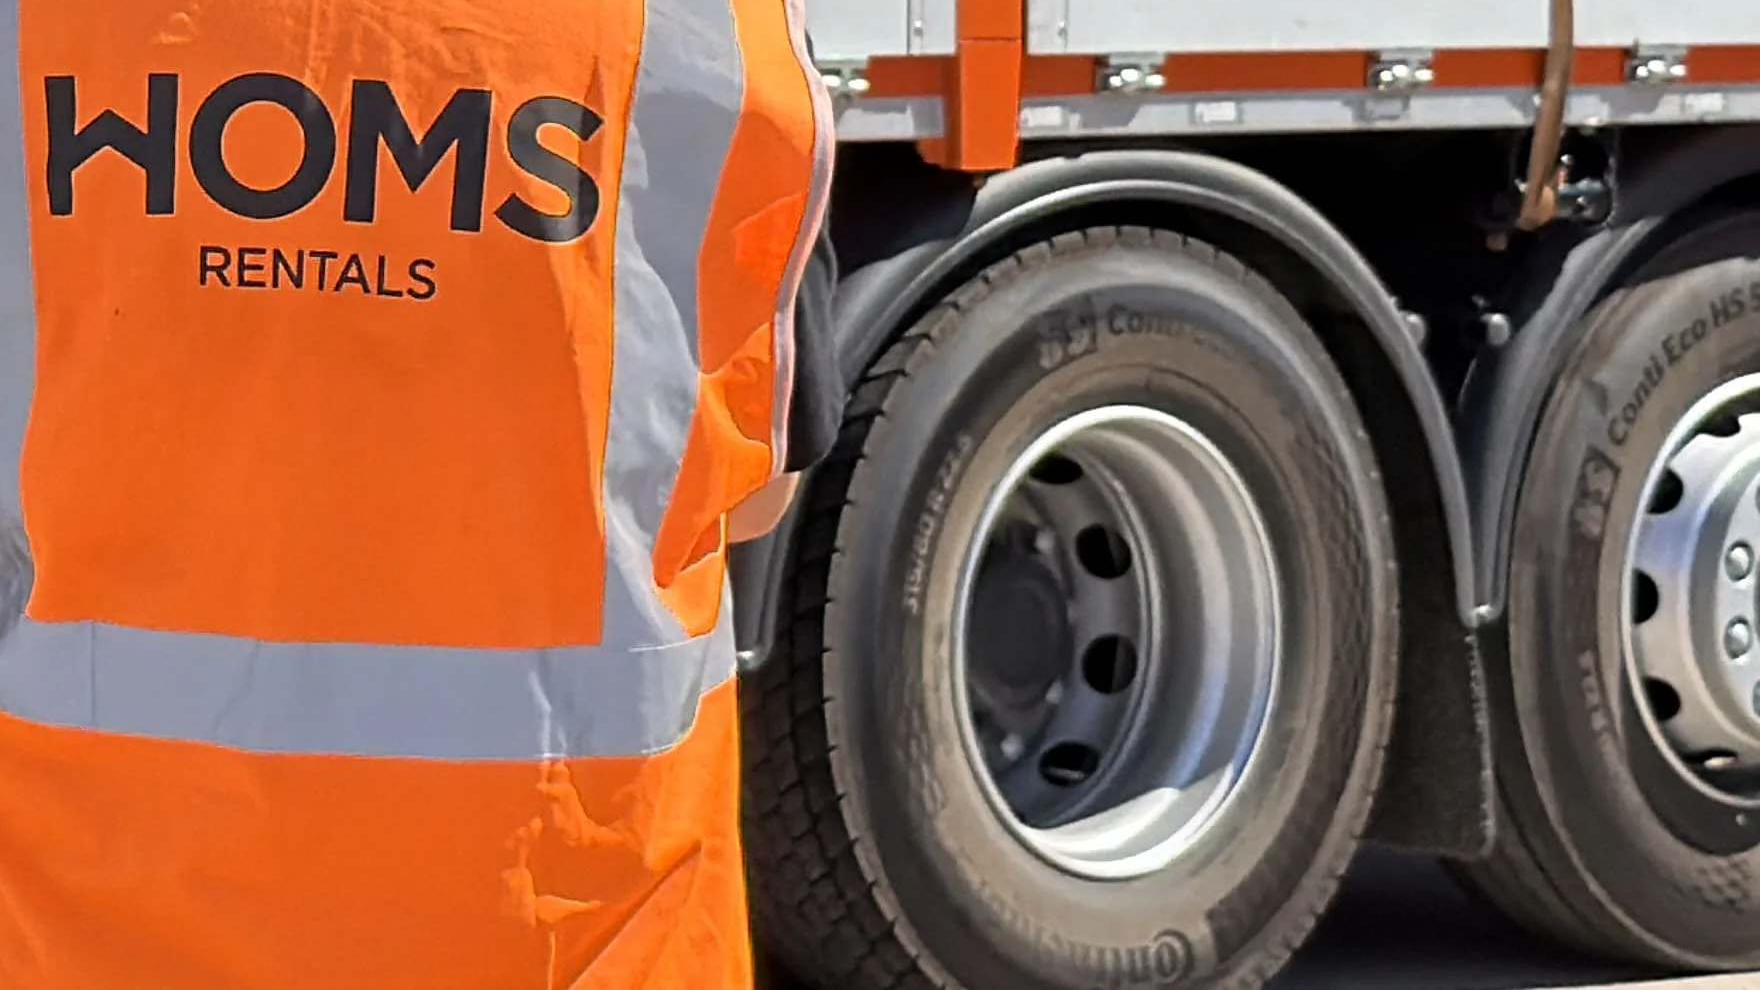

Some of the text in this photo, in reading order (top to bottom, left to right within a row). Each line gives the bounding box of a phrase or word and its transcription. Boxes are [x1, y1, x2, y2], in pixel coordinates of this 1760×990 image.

[44, 72, 604, 243] HOMS
[199, 245, 437, 301] RENTALS
[1608, 355, 1664, 446] Conti
[1661, 321, 1707, 366] Eco
[1710, 287, 1746, 329] HS
